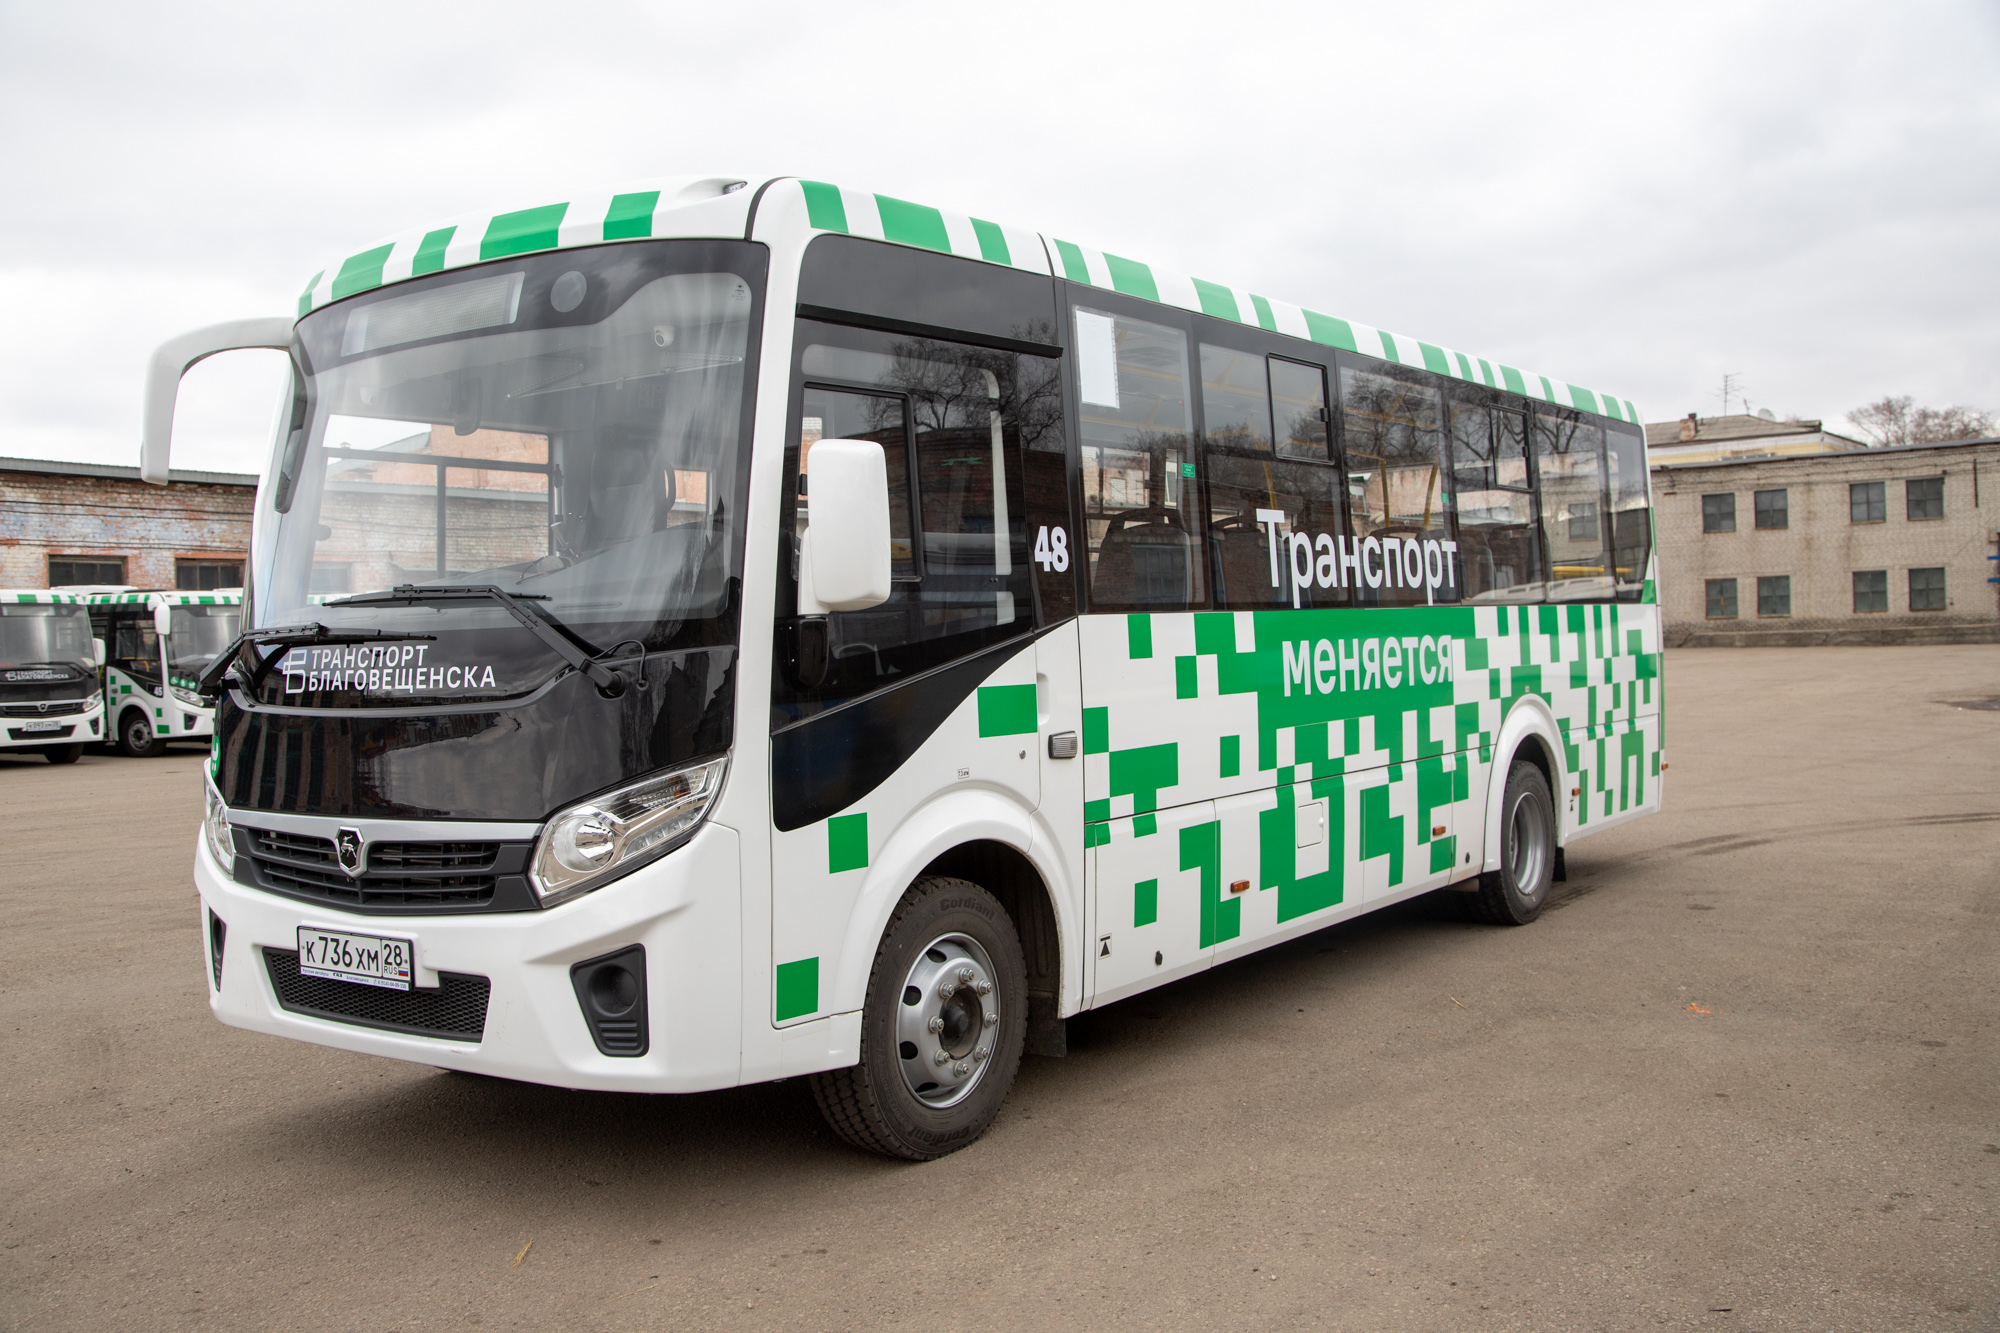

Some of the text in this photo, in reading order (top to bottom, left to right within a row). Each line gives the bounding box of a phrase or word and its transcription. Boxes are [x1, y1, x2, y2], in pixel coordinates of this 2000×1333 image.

[1033, 525, 1070, 573] 48
[1255, 508, 1457, 609] Транспорт
[311, 645, 429, 670] ТРАНСПОРТ
[1281, 634, 1454, 698] меняется
[308, 665, 497, 694] БЛАГОВЕЩЕНСКА
[383, 943, 403, 967] 28
[383, 965, 398, 976] RUS
